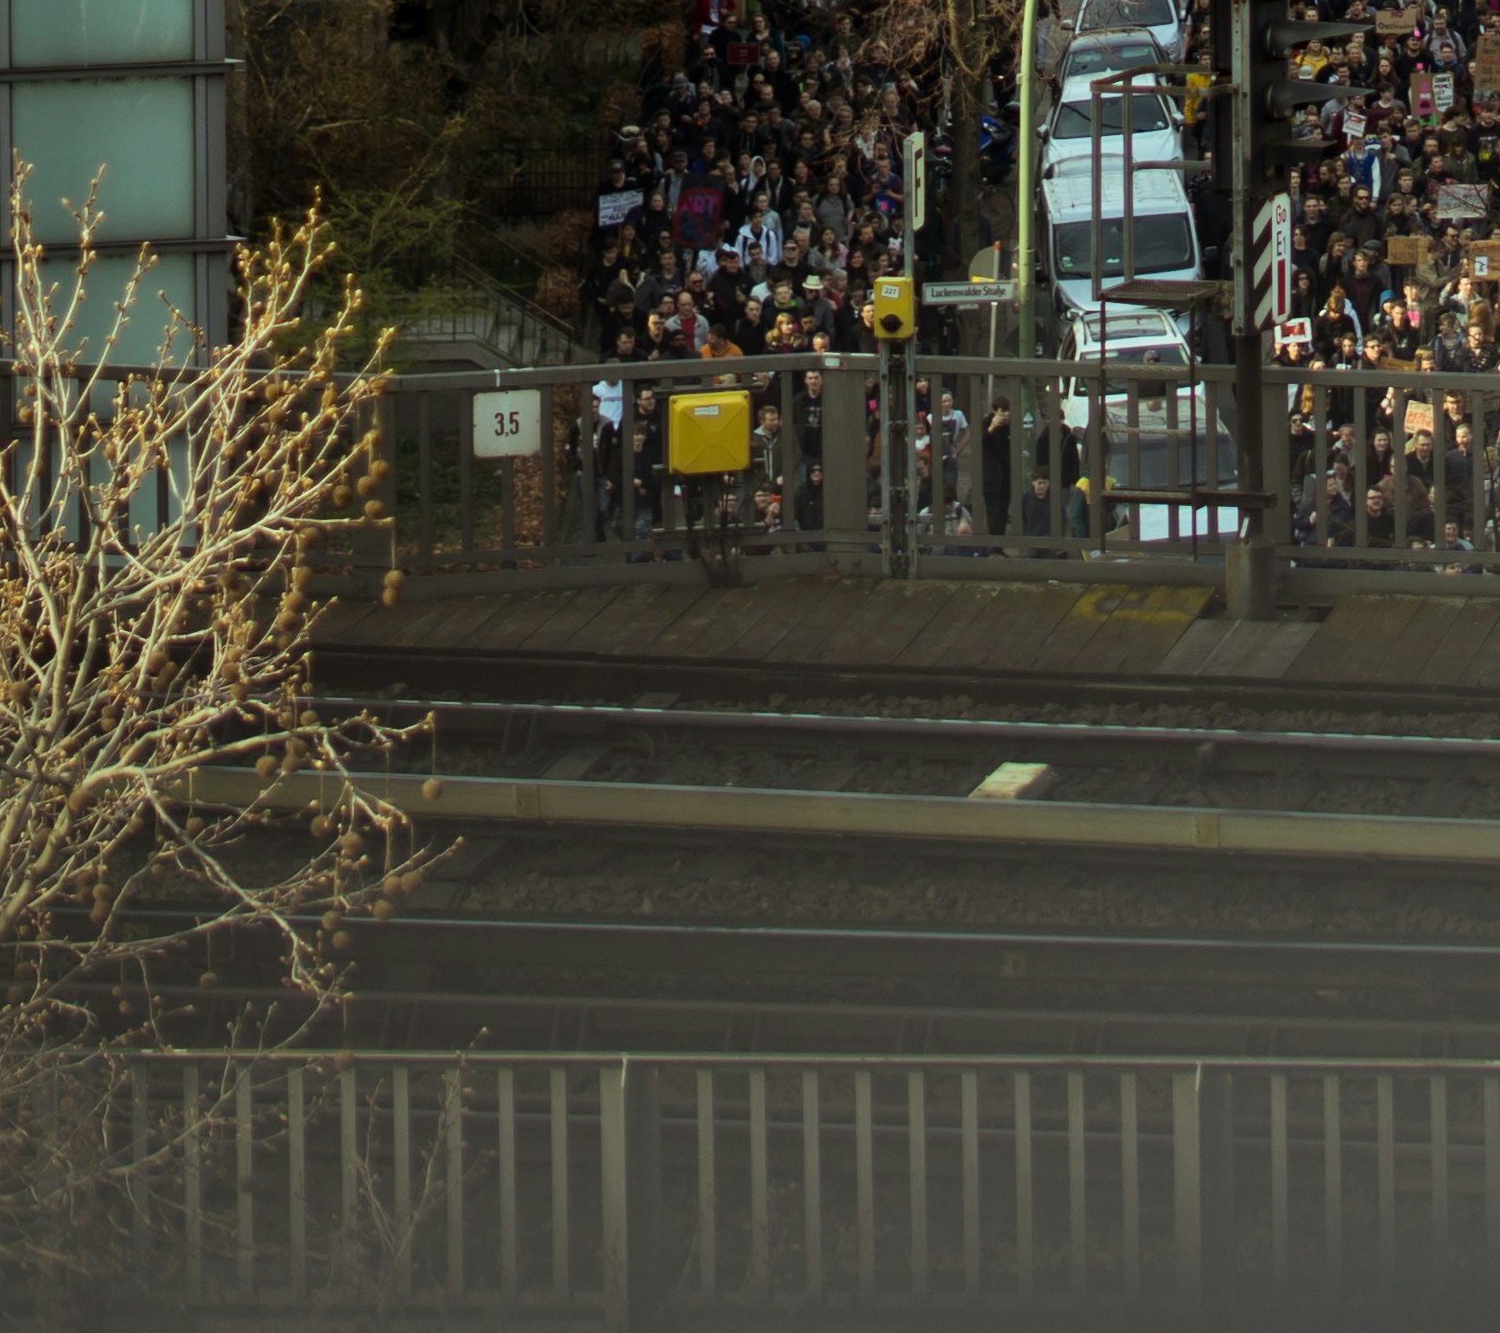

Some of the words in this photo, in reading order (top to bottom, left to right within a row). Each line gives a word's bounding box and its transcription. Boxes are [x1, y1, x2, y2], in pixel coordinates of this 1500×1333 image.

[931, 285, 981, 298] Luckenwalder
[983, 284, 1006, 297] Straße
[494, 411, 519, 437] 3,5
